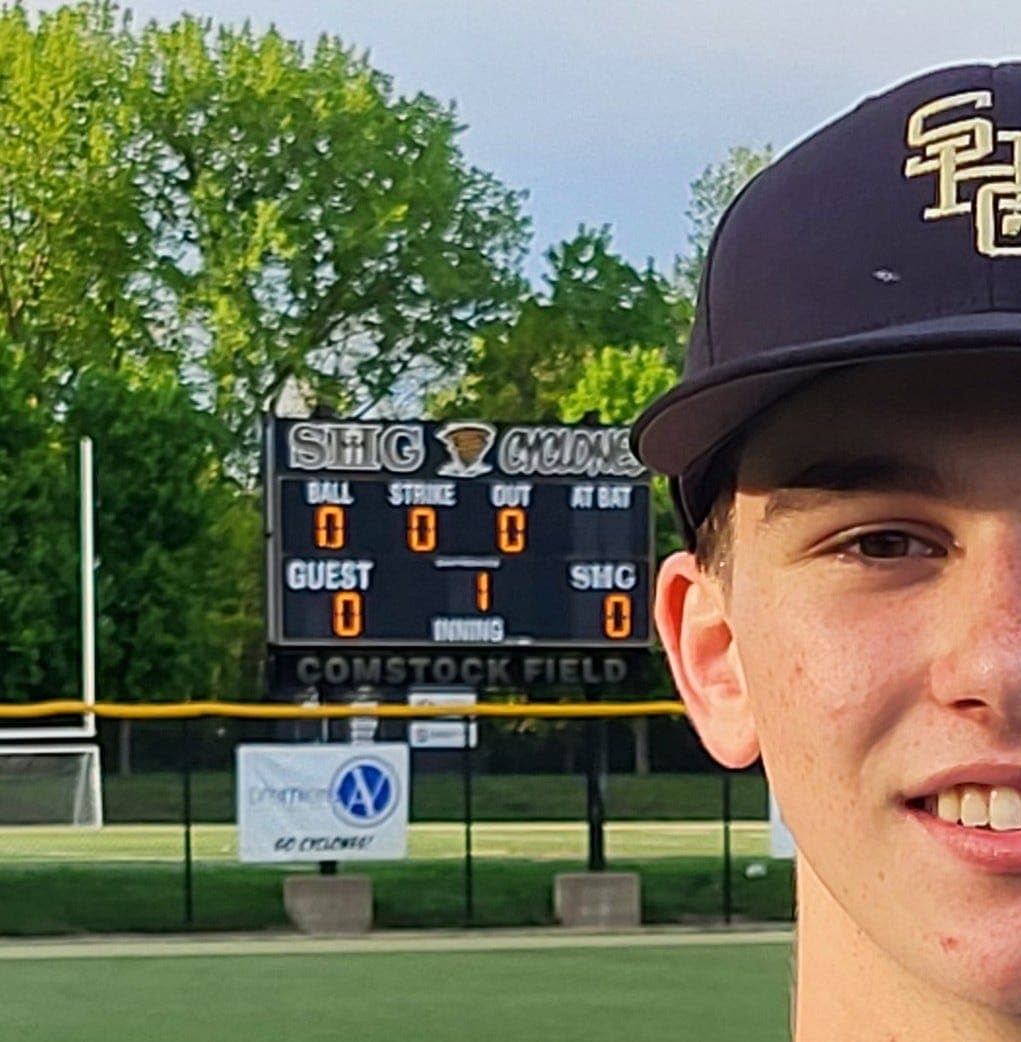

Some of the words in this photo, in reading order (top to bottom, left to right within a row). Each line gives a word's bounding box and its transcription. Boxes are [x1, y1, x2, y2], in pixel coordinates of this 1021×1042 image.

[289, 423, 425, 472] SHG
[499, 427, 647, 477] CYCLONE
[307, 481, 354, 505] BALL
[388, 483, 456, 506] STRIKE
[491, 484, 532, 507] OUT
[571, 485, 594, 508] AT
[597, 485, 632, 508] BAT
[315, 505, 344, 549] 0
[408, 506, 437, 552] 0
[497, 507, 525, 553] 0
[286, 559, 374, 591] GUEST
[569, 564, 636, 590] SHG
[332, 591, 363, 638] 0
[604, 592, 632, 639] 0
[297, 656, 511, 684] COMSTOCK
[524, 656, 627, 684] FIELD
